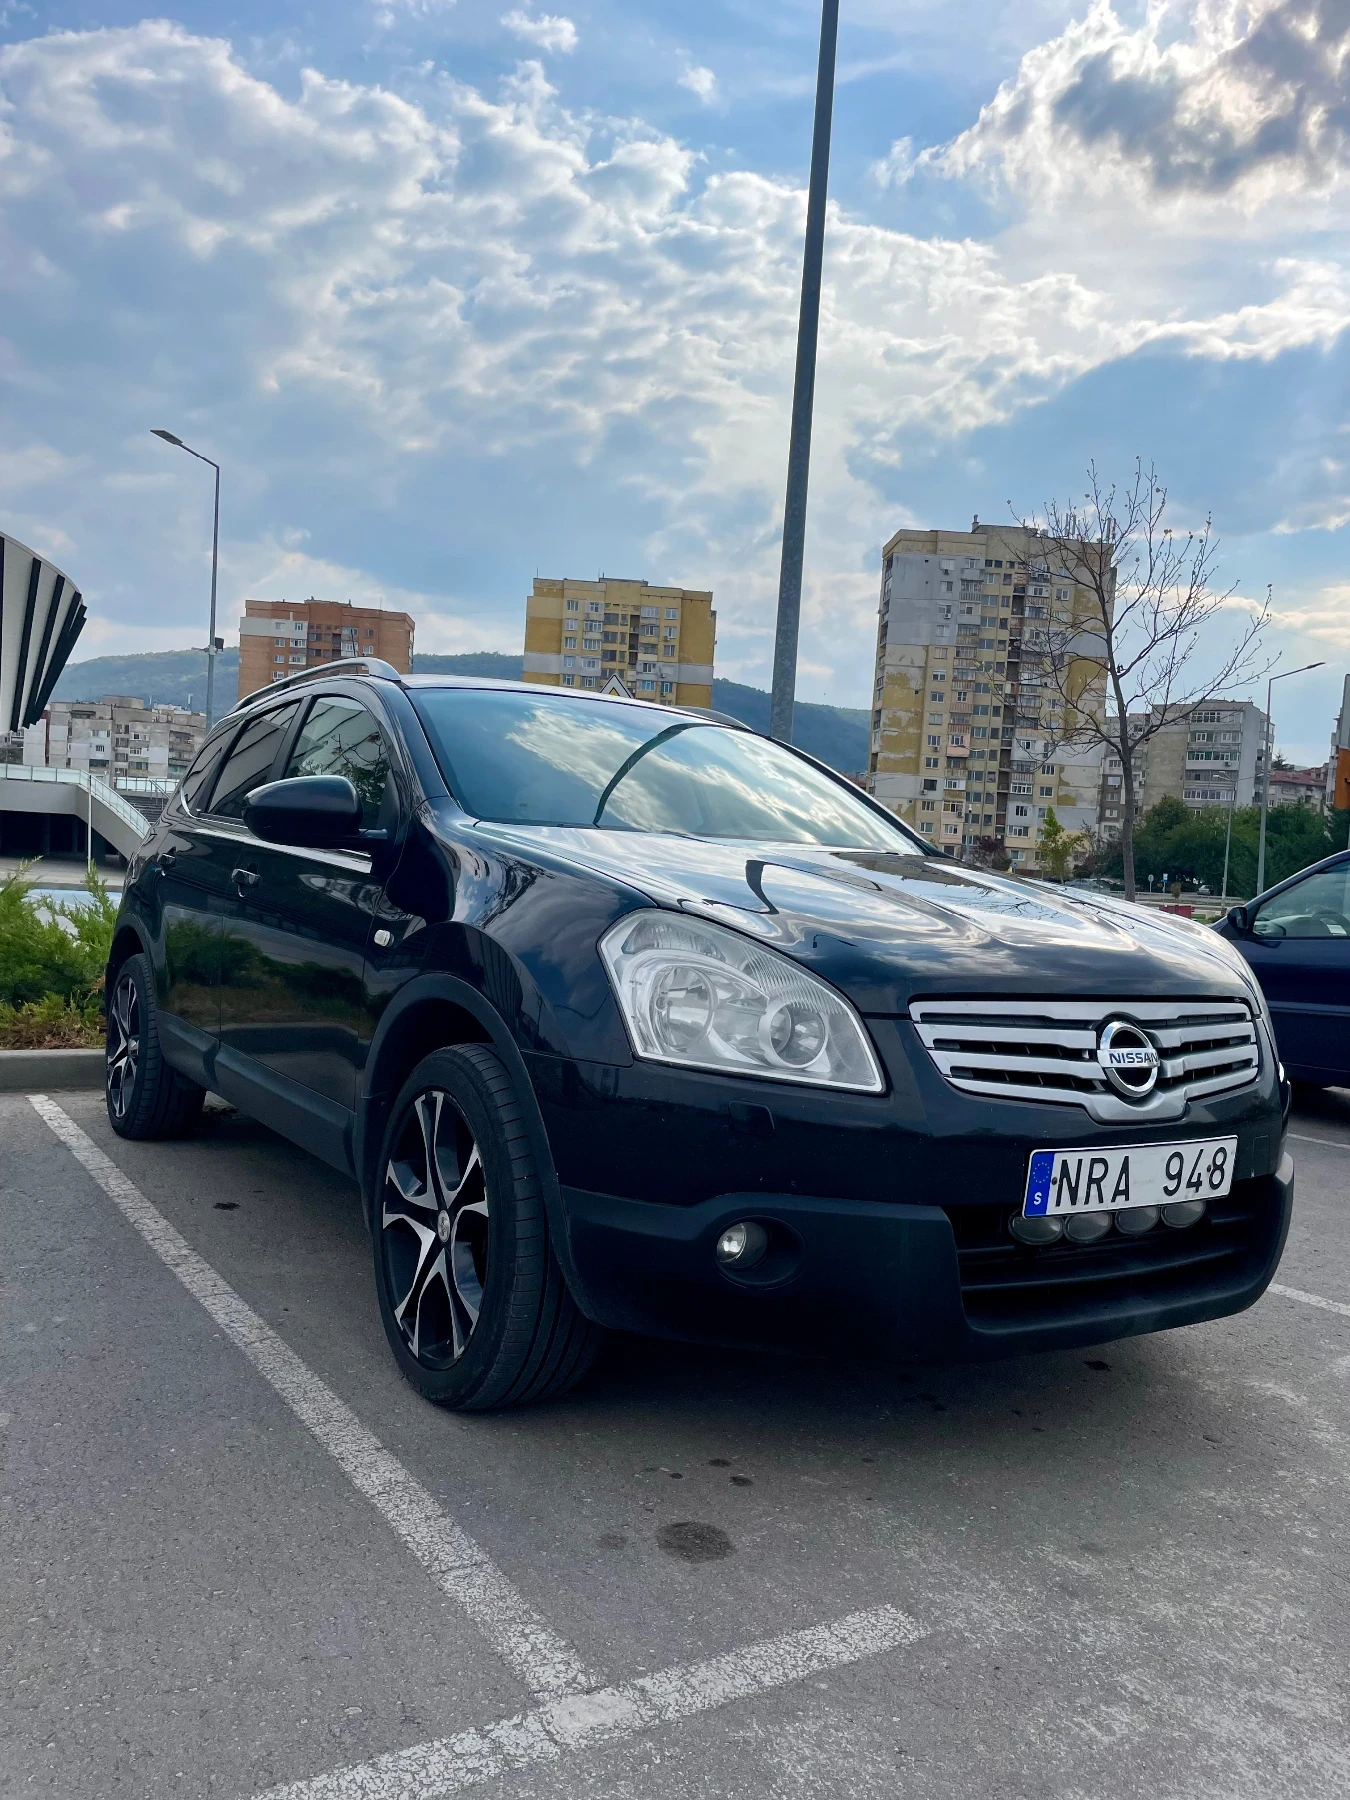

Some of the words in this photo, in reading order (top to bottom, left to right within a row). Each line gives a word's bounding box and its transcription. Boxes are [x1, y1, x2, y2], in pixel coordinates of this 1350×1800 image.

[1109, 1052, 1158, 1064] NISSAN
[1055, 1156, 1130, 1207] NRA
[1163, 1147, 1228, 1197] 948
[1033, 1192, 1042, 1206] S
